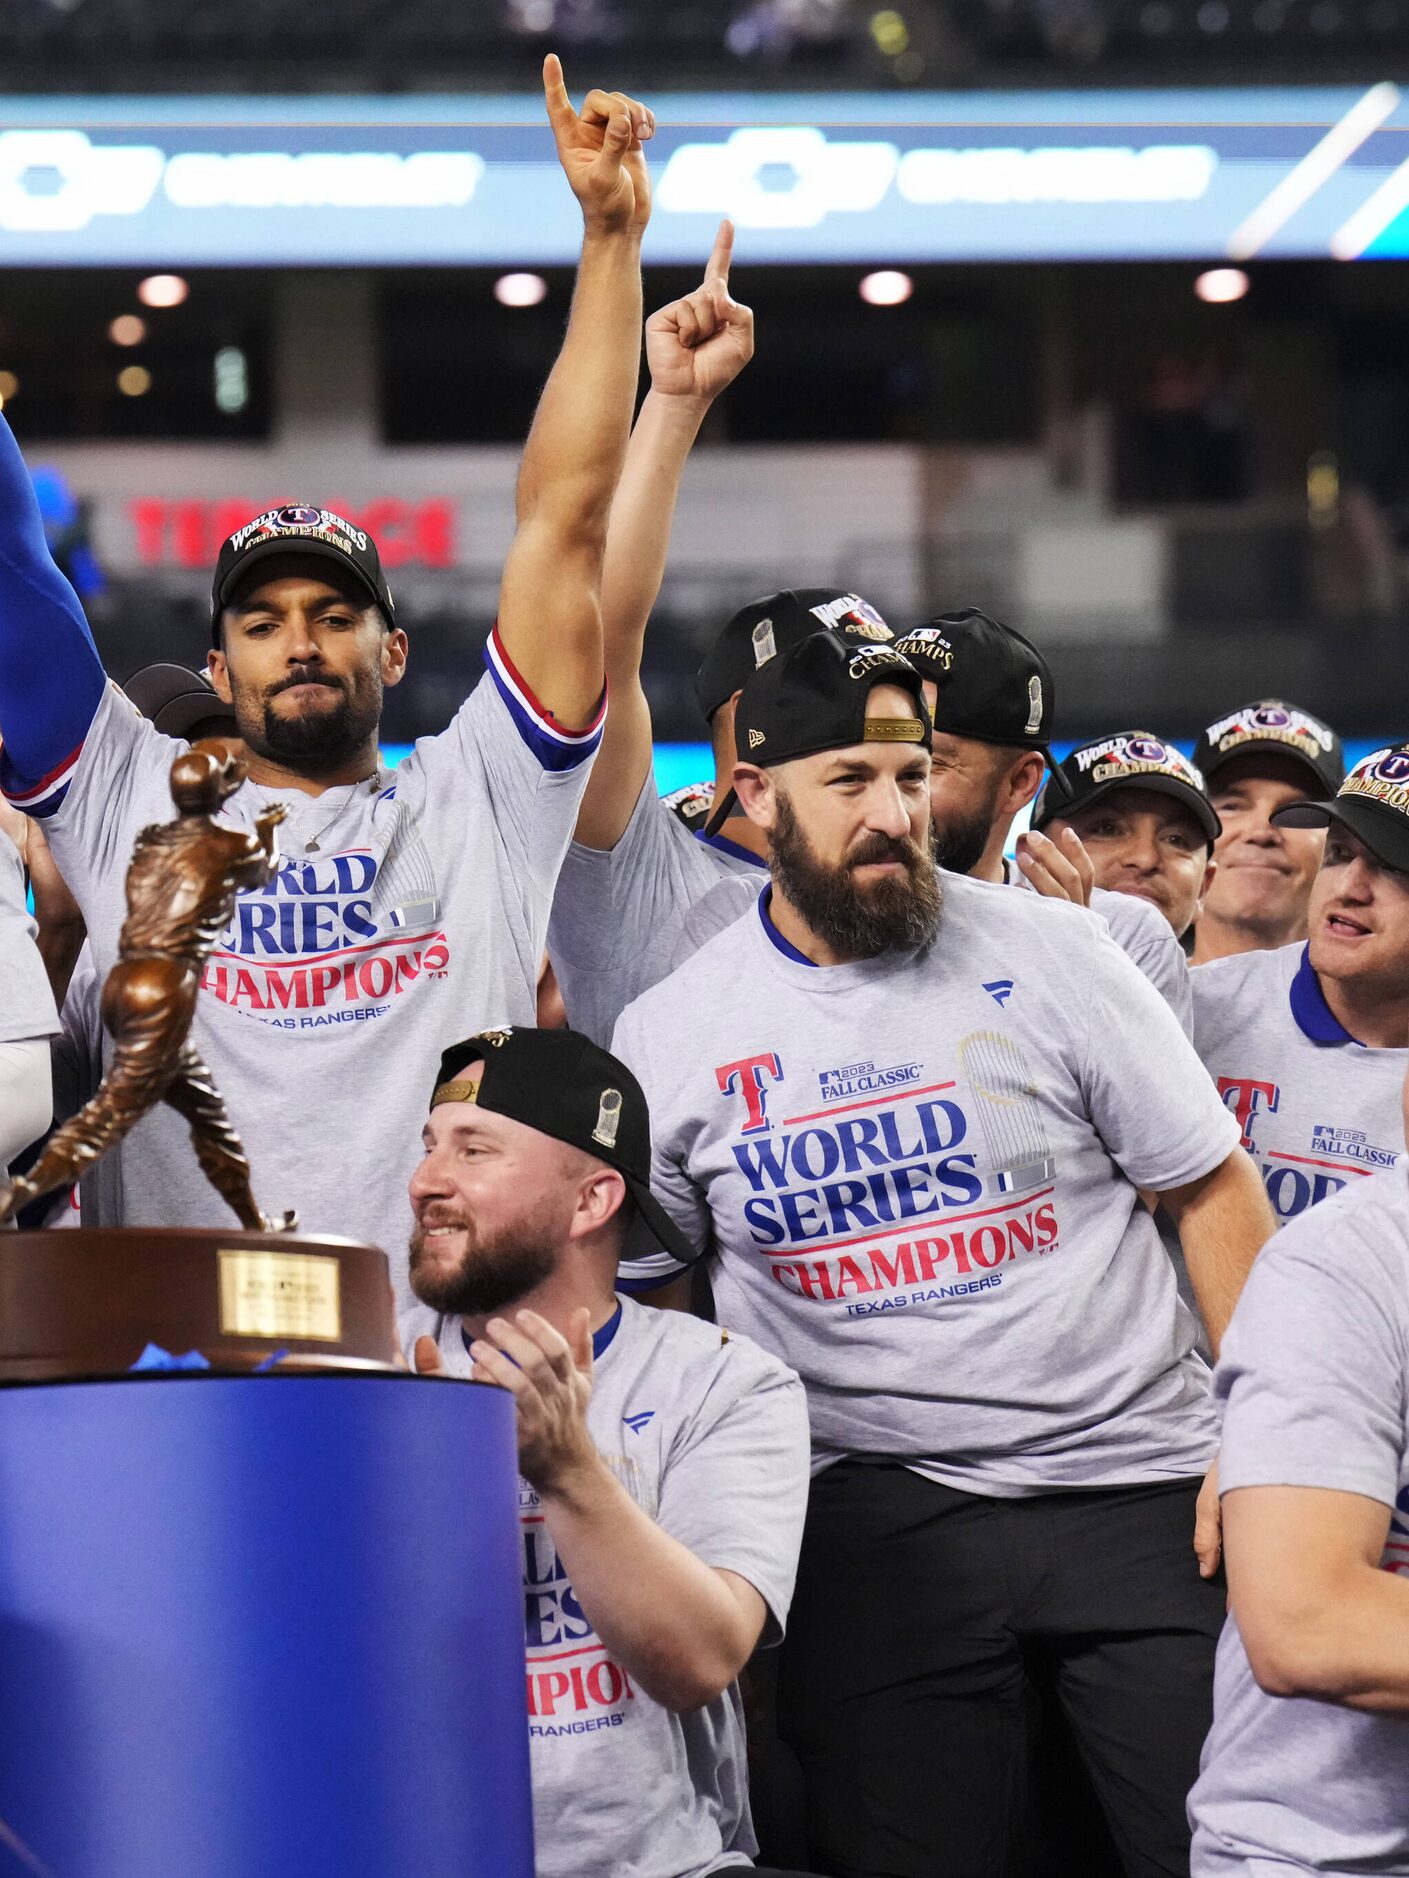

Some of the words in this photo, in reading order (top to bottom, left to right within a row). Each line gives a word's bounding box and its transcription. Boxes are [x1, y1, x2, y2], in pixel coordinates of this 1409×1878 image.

[229, 510, 279, 551] WORLD
[320, 510, 367, 551] SERIES
[896, 640, 954, 670] HAMPS
[1074, 737, 1128, 772] WORLD
[235, 855, 378, 896] RLD
[200, 930, 450, 1010] HAMPIONS
[301, 1006, 388, 1029] RANGERS
[821, 1081, 857, 1101] FALL
[857, 1065, 921, 1091] CLASSIC
[842, 1063, 875, 1079] 2023
[715, 1052, 784, 1136] T
[1217, 1076, 1280, 1154] T
[731, 1099, 968, 1192] WORLD
[1311, 1137, 1343, 1154] FALL
[1346, 1144, 1398, 1167] CLASSIC
[1335, 1130, 1367, 1143] 2023
[742, 1153, 983, 1246] SERIES
[772, 1203, 1059, 1301] CHAMPIONS
[846, 1295, 908, 1317] TEXAS
[912, 1274, 1002, 1303] RANGERS
[530, 1712, 625, 1737] RANGERS
